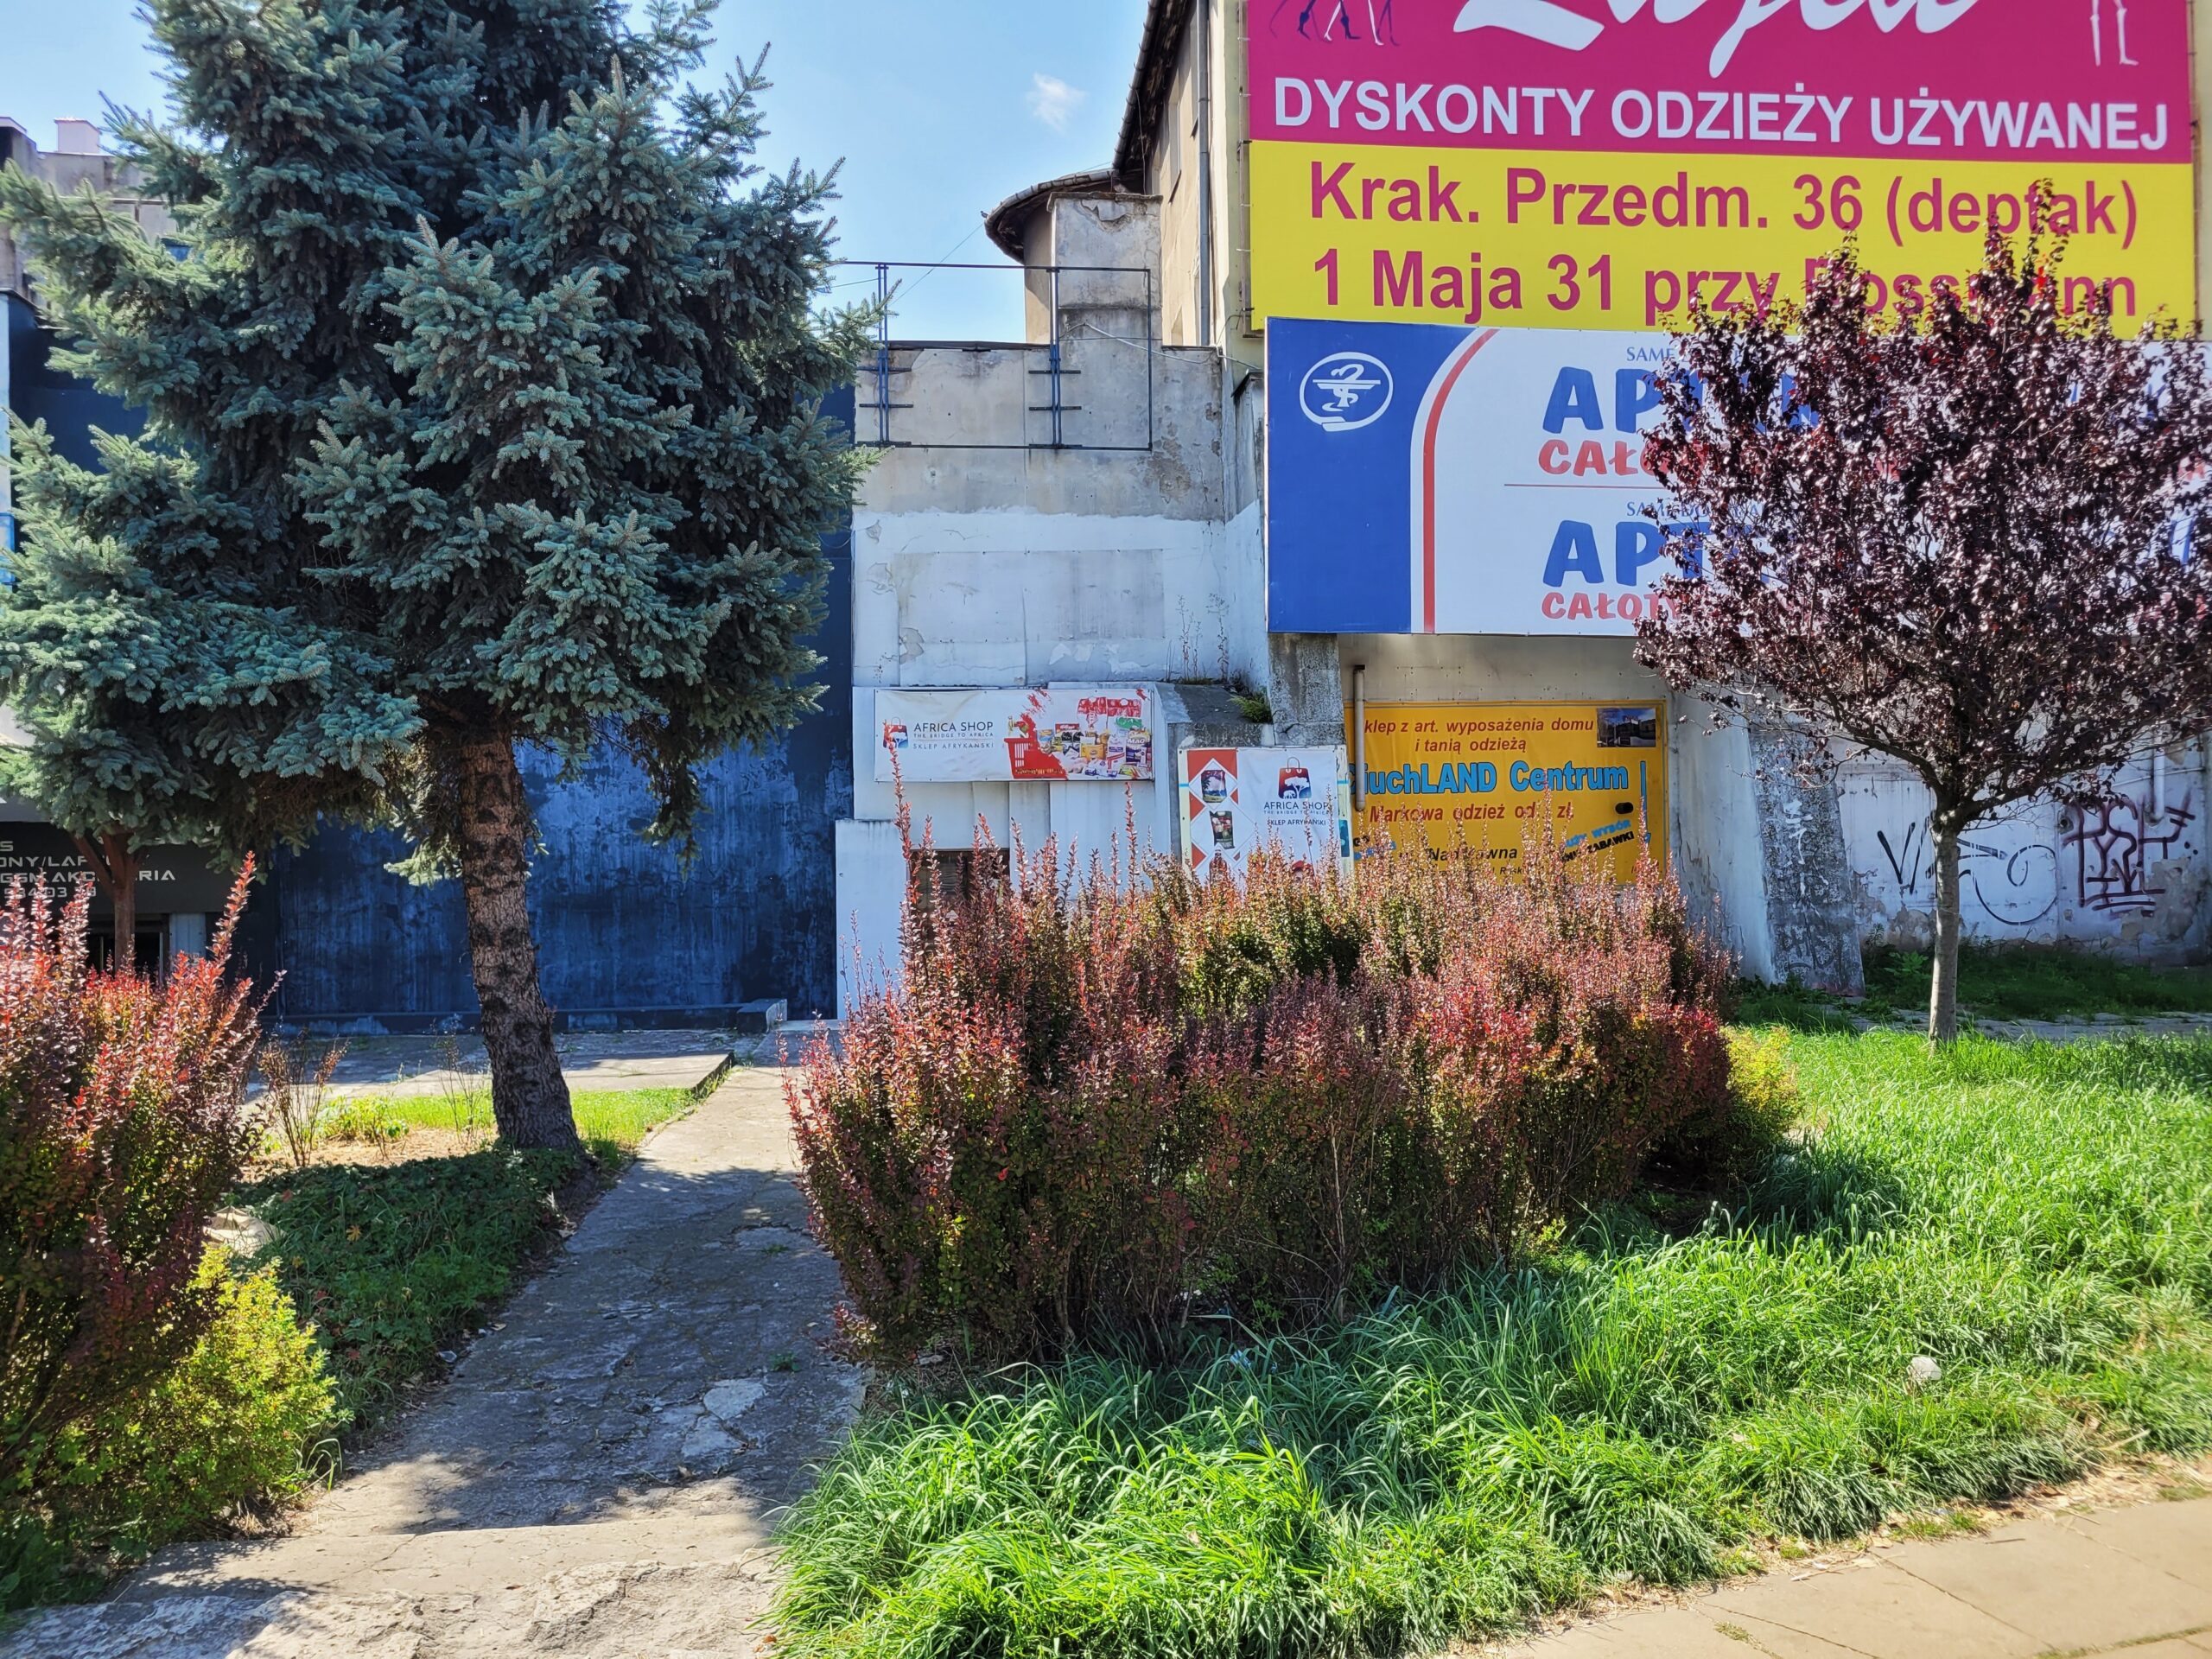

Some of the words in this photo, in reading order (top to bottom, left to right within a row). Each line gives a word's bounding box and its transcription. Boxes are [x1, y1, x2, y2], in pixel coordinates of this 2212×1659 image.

[1274, 77, 1595, 137] DYSKONTY
[1611, 82, 1853, 143] ODZIEŻY
[1870, 86, 2168, 150] UŻYWANEJ
[1310, 160, 1480, 224] Krak.
[1506, 167, 1769, 228] Przedm.
[1792, 174, 1863, 232] 36
[1313, 247, 1339, 306] 1
[1372, 249, 1522, 324] Maja
[1547, 253, 1611, 311] 31
[1644, 270, 1781, 327] przy
[913, 722, 957, 733] AFRICA
[960, 721, 995, 732] SHOP
[1364, 719, 1397, 735] klep
[1400, 721, 1409, 733] z
[1414, 720, 1439, 733] art.
[1446, 717, 1545, 736] wyposażenia
[1551, 716, 1595, 732] domu
[1424, 739, 1462, 754] tanią
[1469, 737, 1528, 753] odzieżą
[1509, 760, 1629, 793] Centrum
[1263, 801, 1300, 810] AFRICA
[1302, 801, 1330, 810] SHOP
